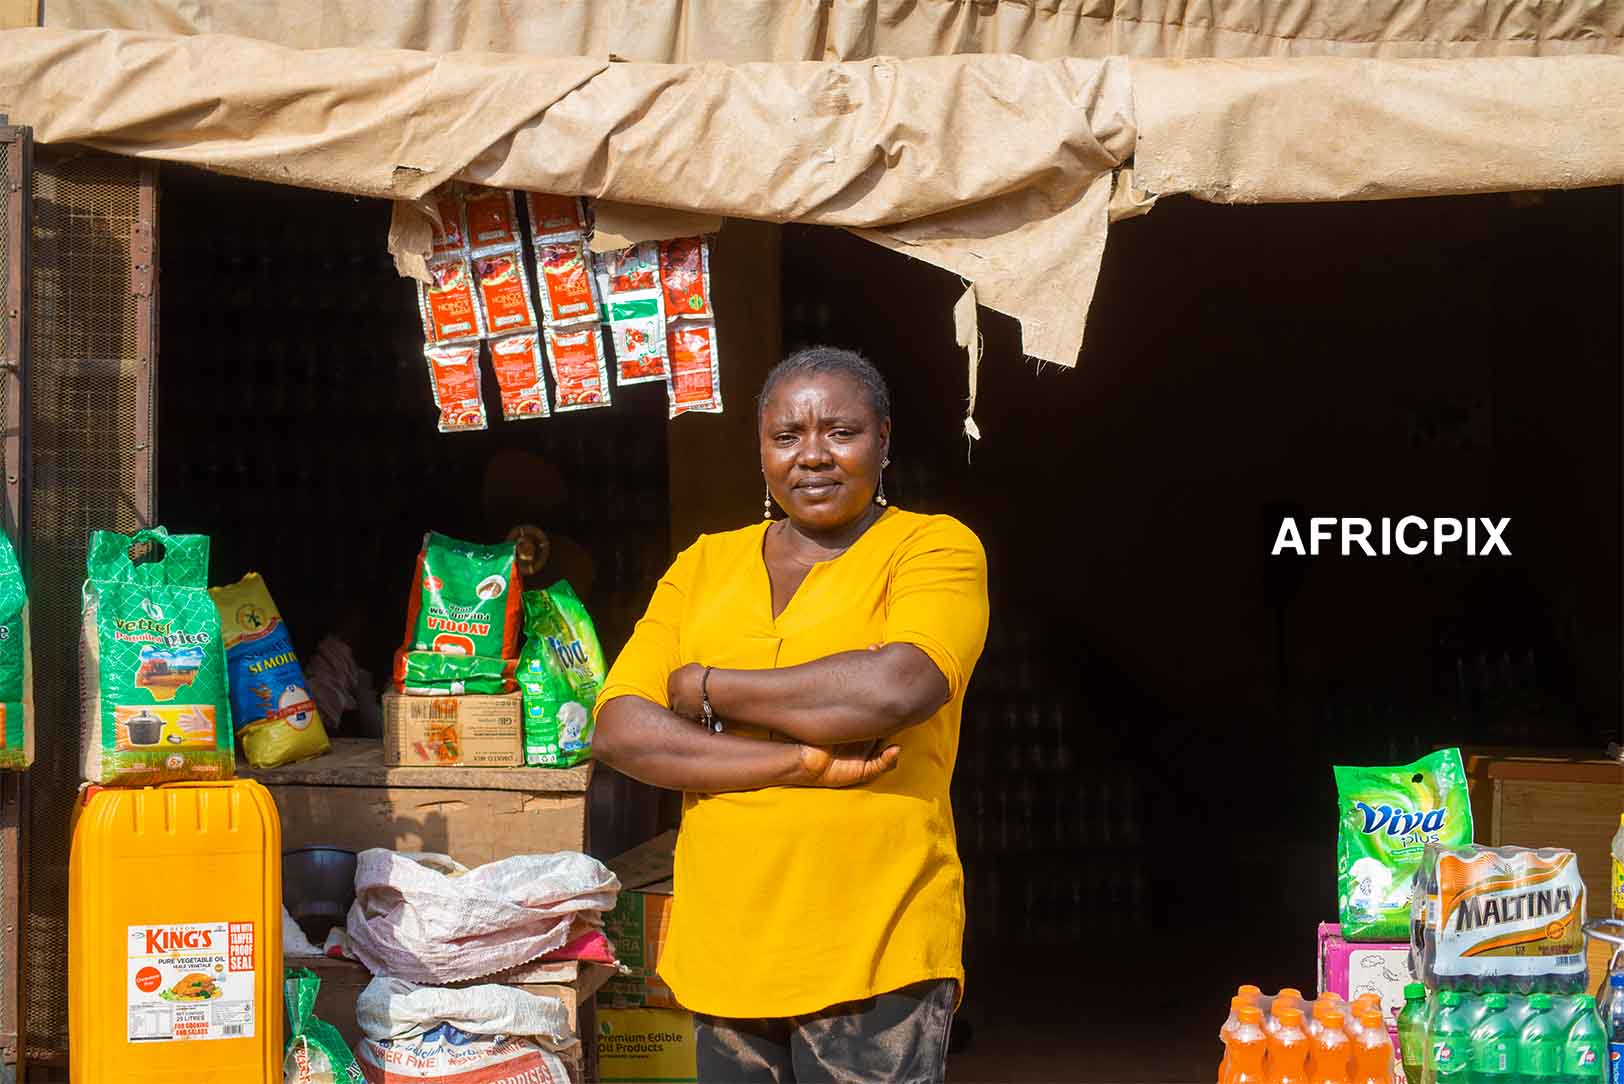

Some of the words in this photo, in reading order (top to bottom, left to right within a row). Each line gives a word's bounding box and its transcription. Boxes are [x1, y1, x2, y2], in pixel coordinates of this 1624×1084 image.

[427, 616, 490, 636] AYOOLA
[1356, 802, 1447, 836] Viva
[1401, 832, 1440, 848] plus
[1456, 887, 1572, 931] MALTINA
[145, 928, 213, 953] KING'S
[231, 945, 253, 956] PROOF
[231, 956, 253, 970] SEAL
[597, 1032, 645, 1043] Premium
[648, 1032, 683, 1042] Edible
[616, 1043, 664, 1053] Products
